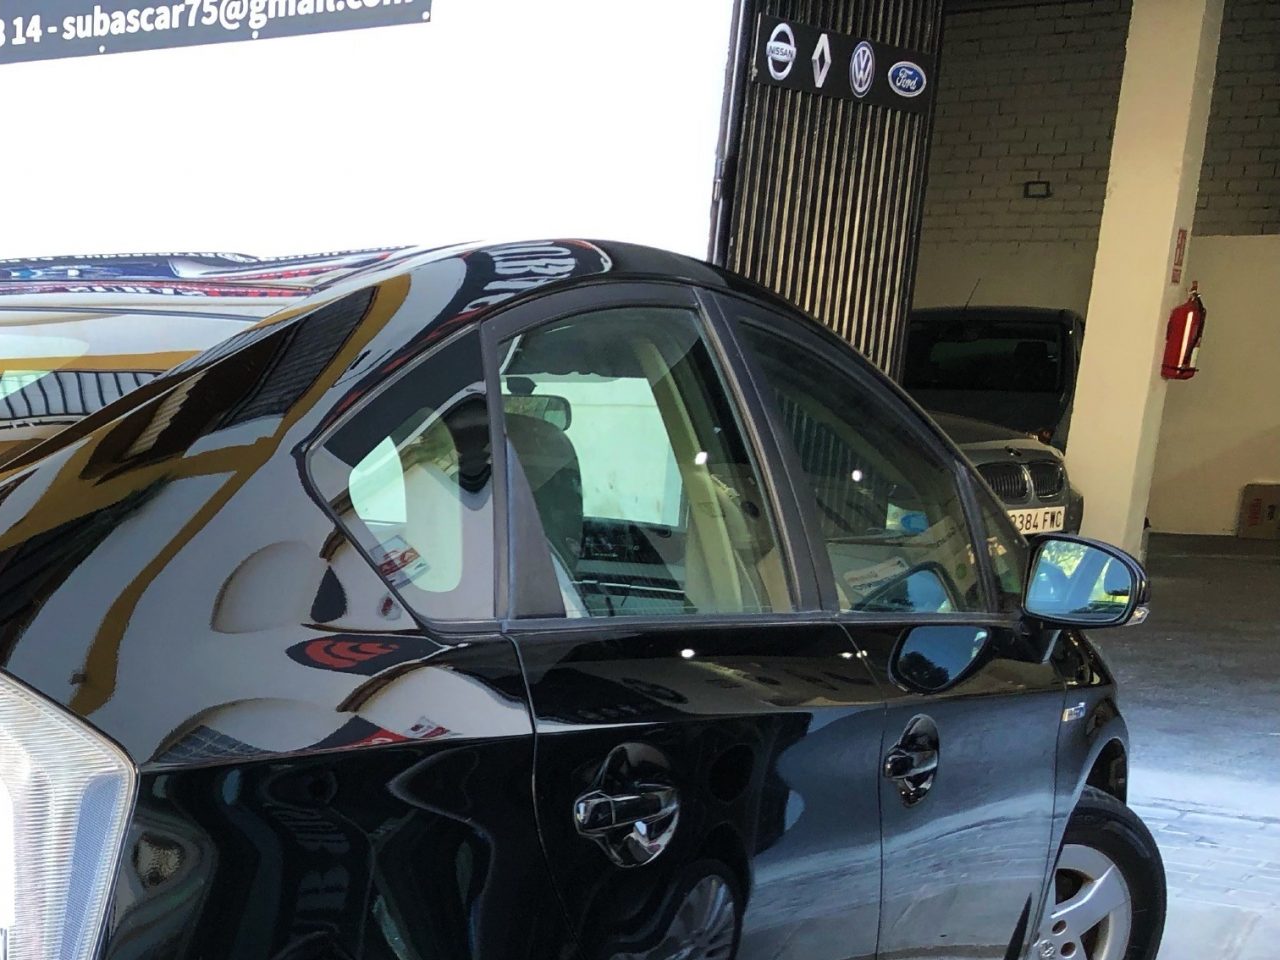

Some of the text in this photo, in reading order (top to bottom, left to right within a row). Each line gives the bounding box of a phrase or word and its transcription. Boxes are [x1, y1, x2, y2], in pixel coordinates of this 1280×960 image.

[12, 15, 42, 45] 14
[62, 0, 414, 40] subascar75@gma.
[769, 46, 794, 58] NISSAN
[895, 68, 920, 90] Ford
